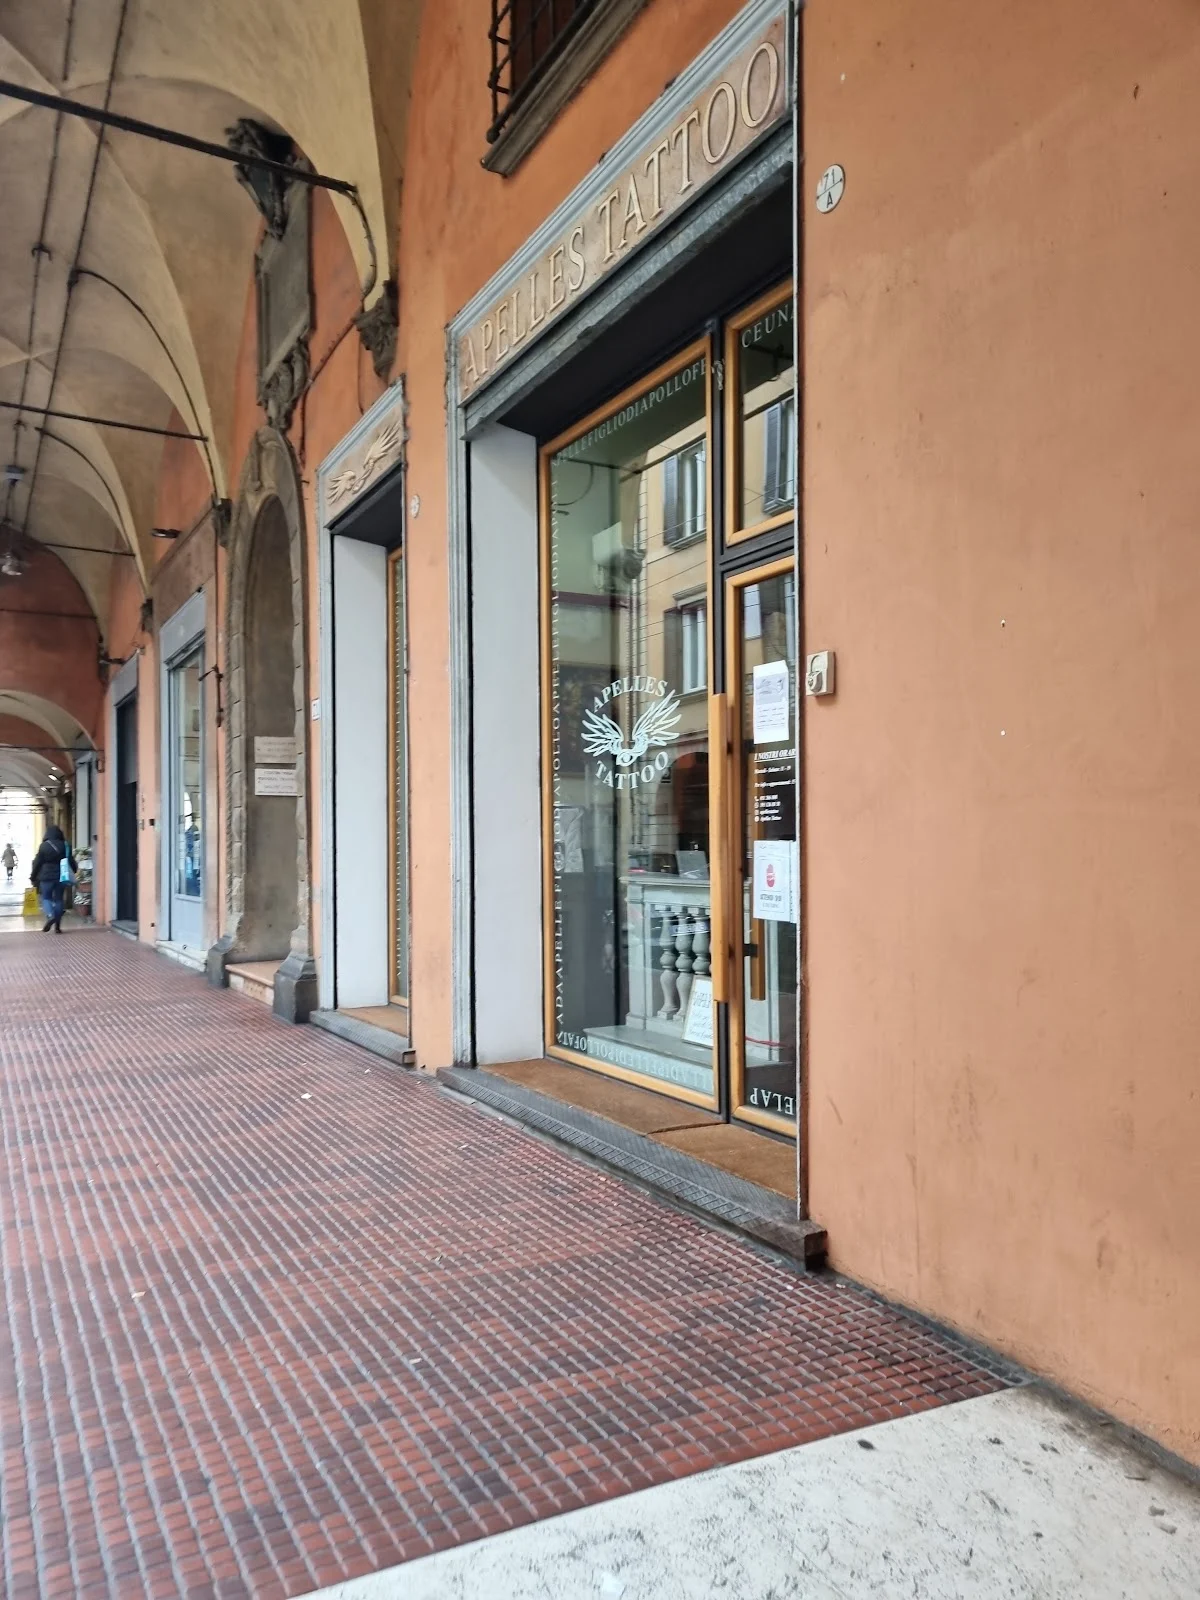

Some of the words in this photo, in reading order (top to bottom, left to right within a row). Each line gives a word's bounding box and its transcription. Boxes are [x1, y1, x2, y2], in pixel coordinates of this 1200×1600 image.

[824, 168, 835, 191] 71
[459, 226, 586, 392] APELLES
[596, 41, 779, 264] TATTOO
[826, 191, 833, 208] A
[593, 675, 668, 713] APELLES
[595, 751, 669, 790] TATTOO
